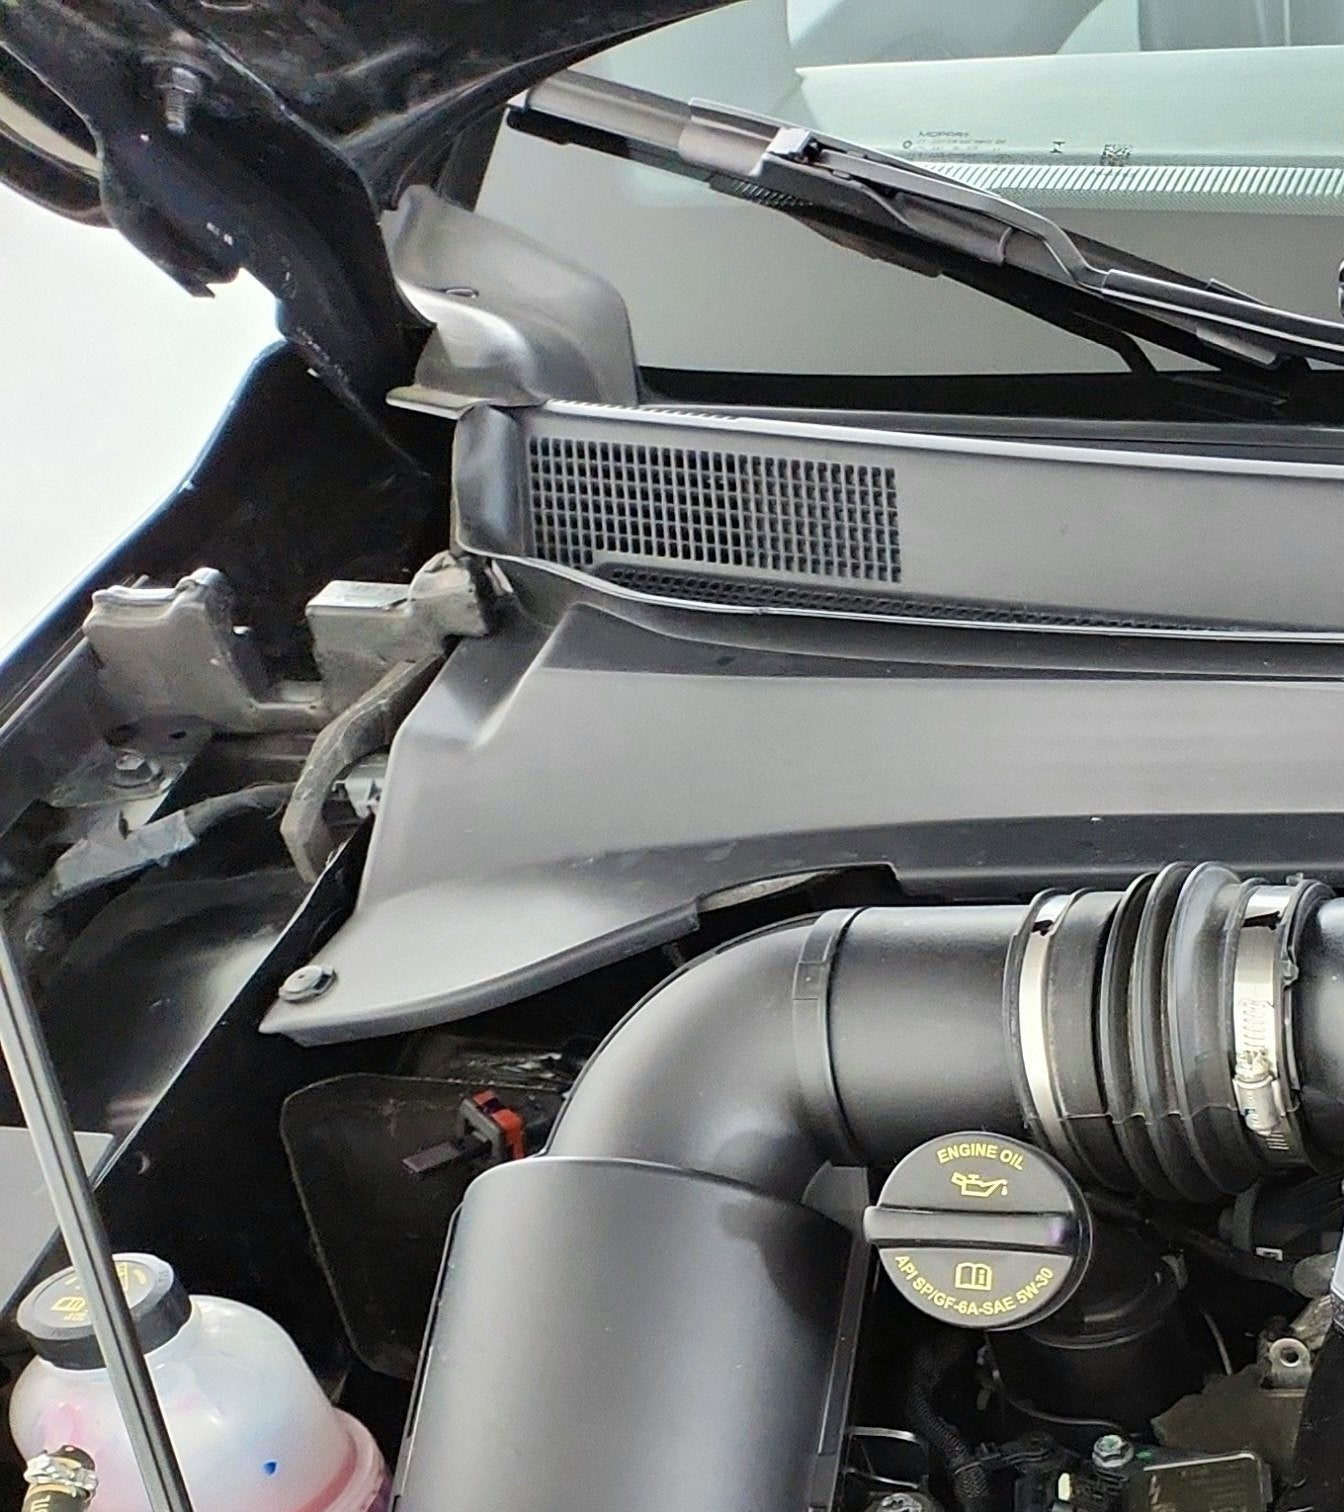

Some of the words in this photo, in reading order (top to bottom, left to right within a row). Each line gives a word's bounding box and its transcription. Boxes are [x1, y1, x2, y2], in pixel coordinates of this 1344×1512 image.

[937, 1143, 998, 1164] ENGINE
[1000, 1149, 1024, 1170] OIL
[895, 1255, 918, 1280] API
[912, 1275, 1017, 1316] SP/GF-6A-SAE
[1016, 1267, 1054, 1304] 5W-30
